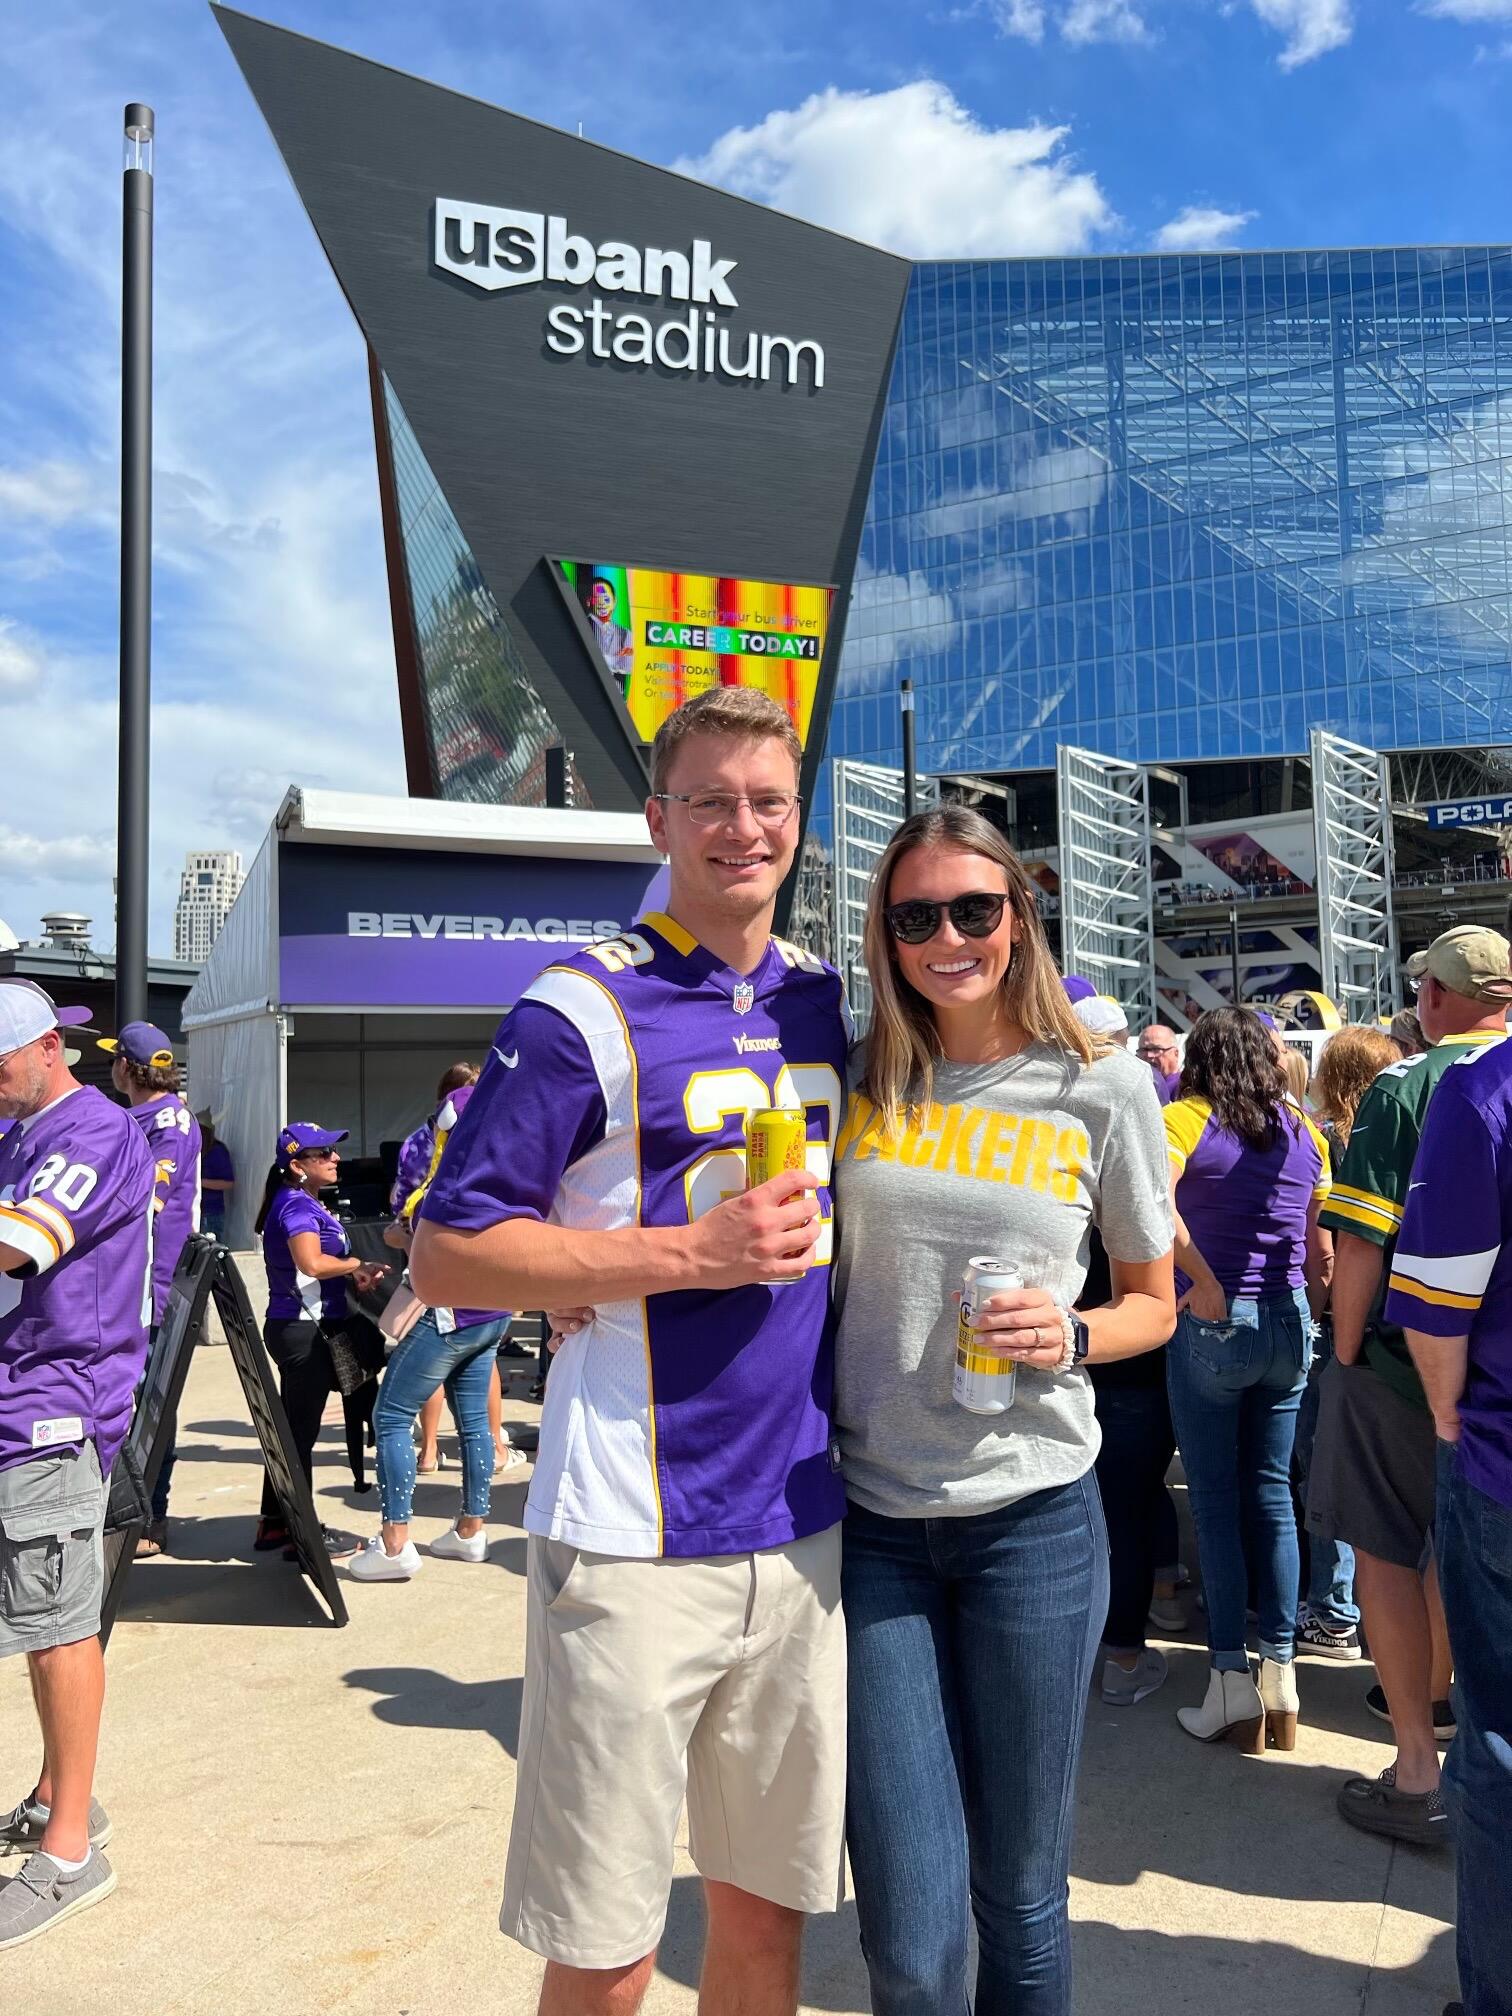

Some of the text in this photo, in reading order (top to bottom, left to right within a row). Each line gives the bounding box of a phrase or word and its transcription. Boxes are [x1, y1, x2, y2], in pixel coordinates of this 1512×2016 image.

[546, 299, 825, 388] stadium
[686, 605, 719, 618] Start
[755, 613, 776, 625] bus
[647, 626, 815, 657] CAREER TODAY!
[348, 911, 622, 944] BEVERAGES
[736, 997, 751, 1009] NFL
[29, 1153, 98, 1212] 80
